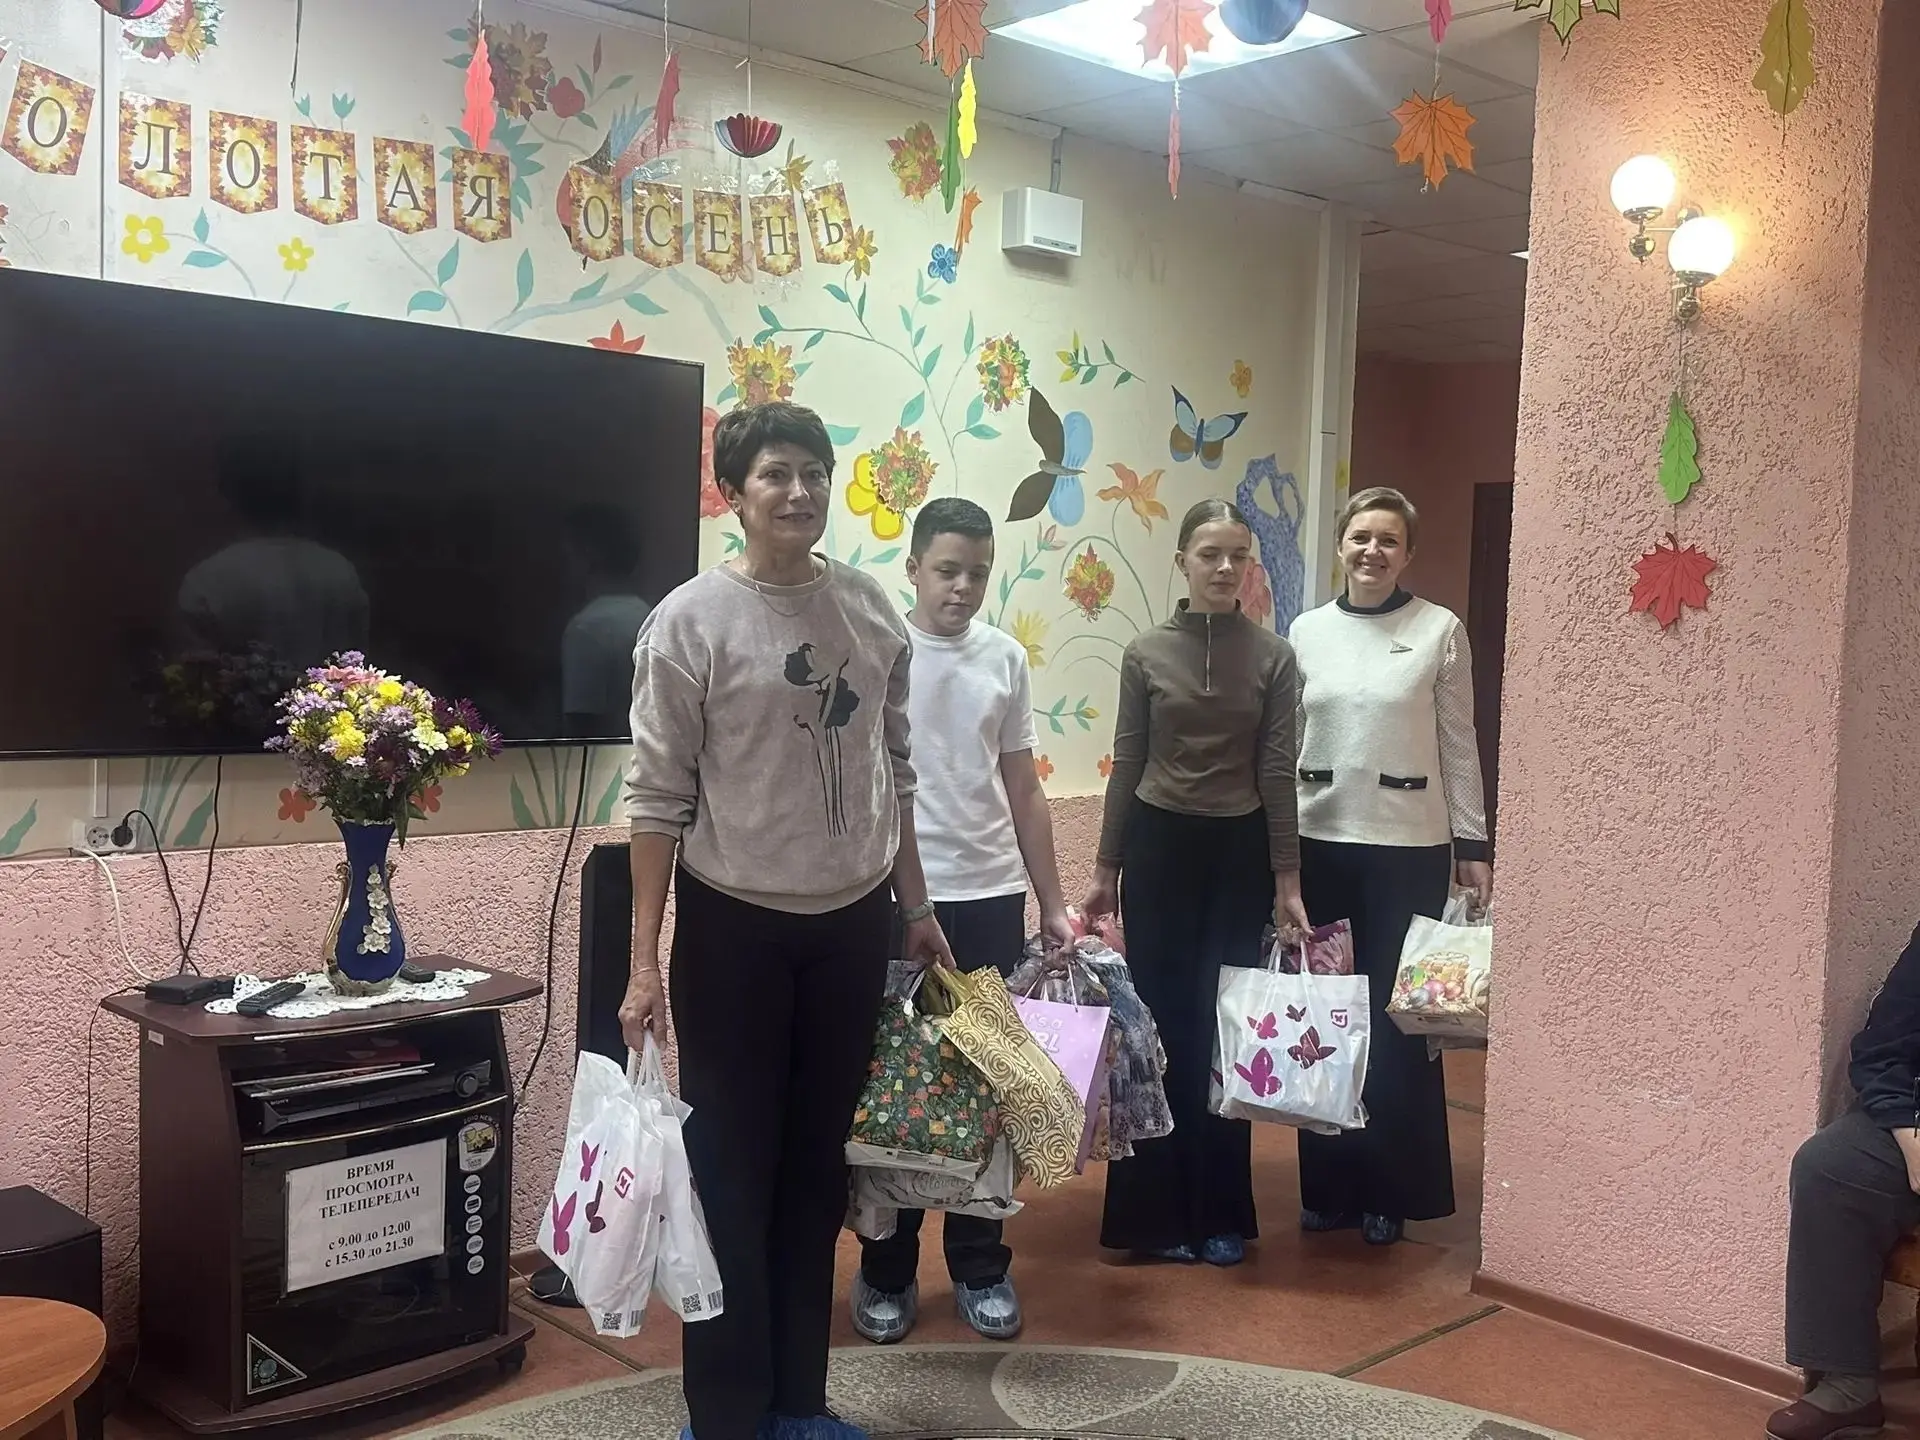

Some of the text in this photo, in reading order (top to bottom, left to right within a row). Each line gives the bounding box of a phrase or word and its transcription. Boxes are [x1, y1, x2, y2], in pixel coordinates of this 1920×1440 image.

[582, 195, 844, 256] ОСЕНЬ
[346, 1159, 395, 1180] ВРЕМЯ
[325, 1172, 414, 1201] ПРОСМОТРА
[319, 1186, 420, 1219] ТЕЛЕПЕРЕДАЧ
[328, 1220, 411, 1250] с 9.00 до 12.00
[325, 1236, 414, 1268] с 15.30 до 21.30
